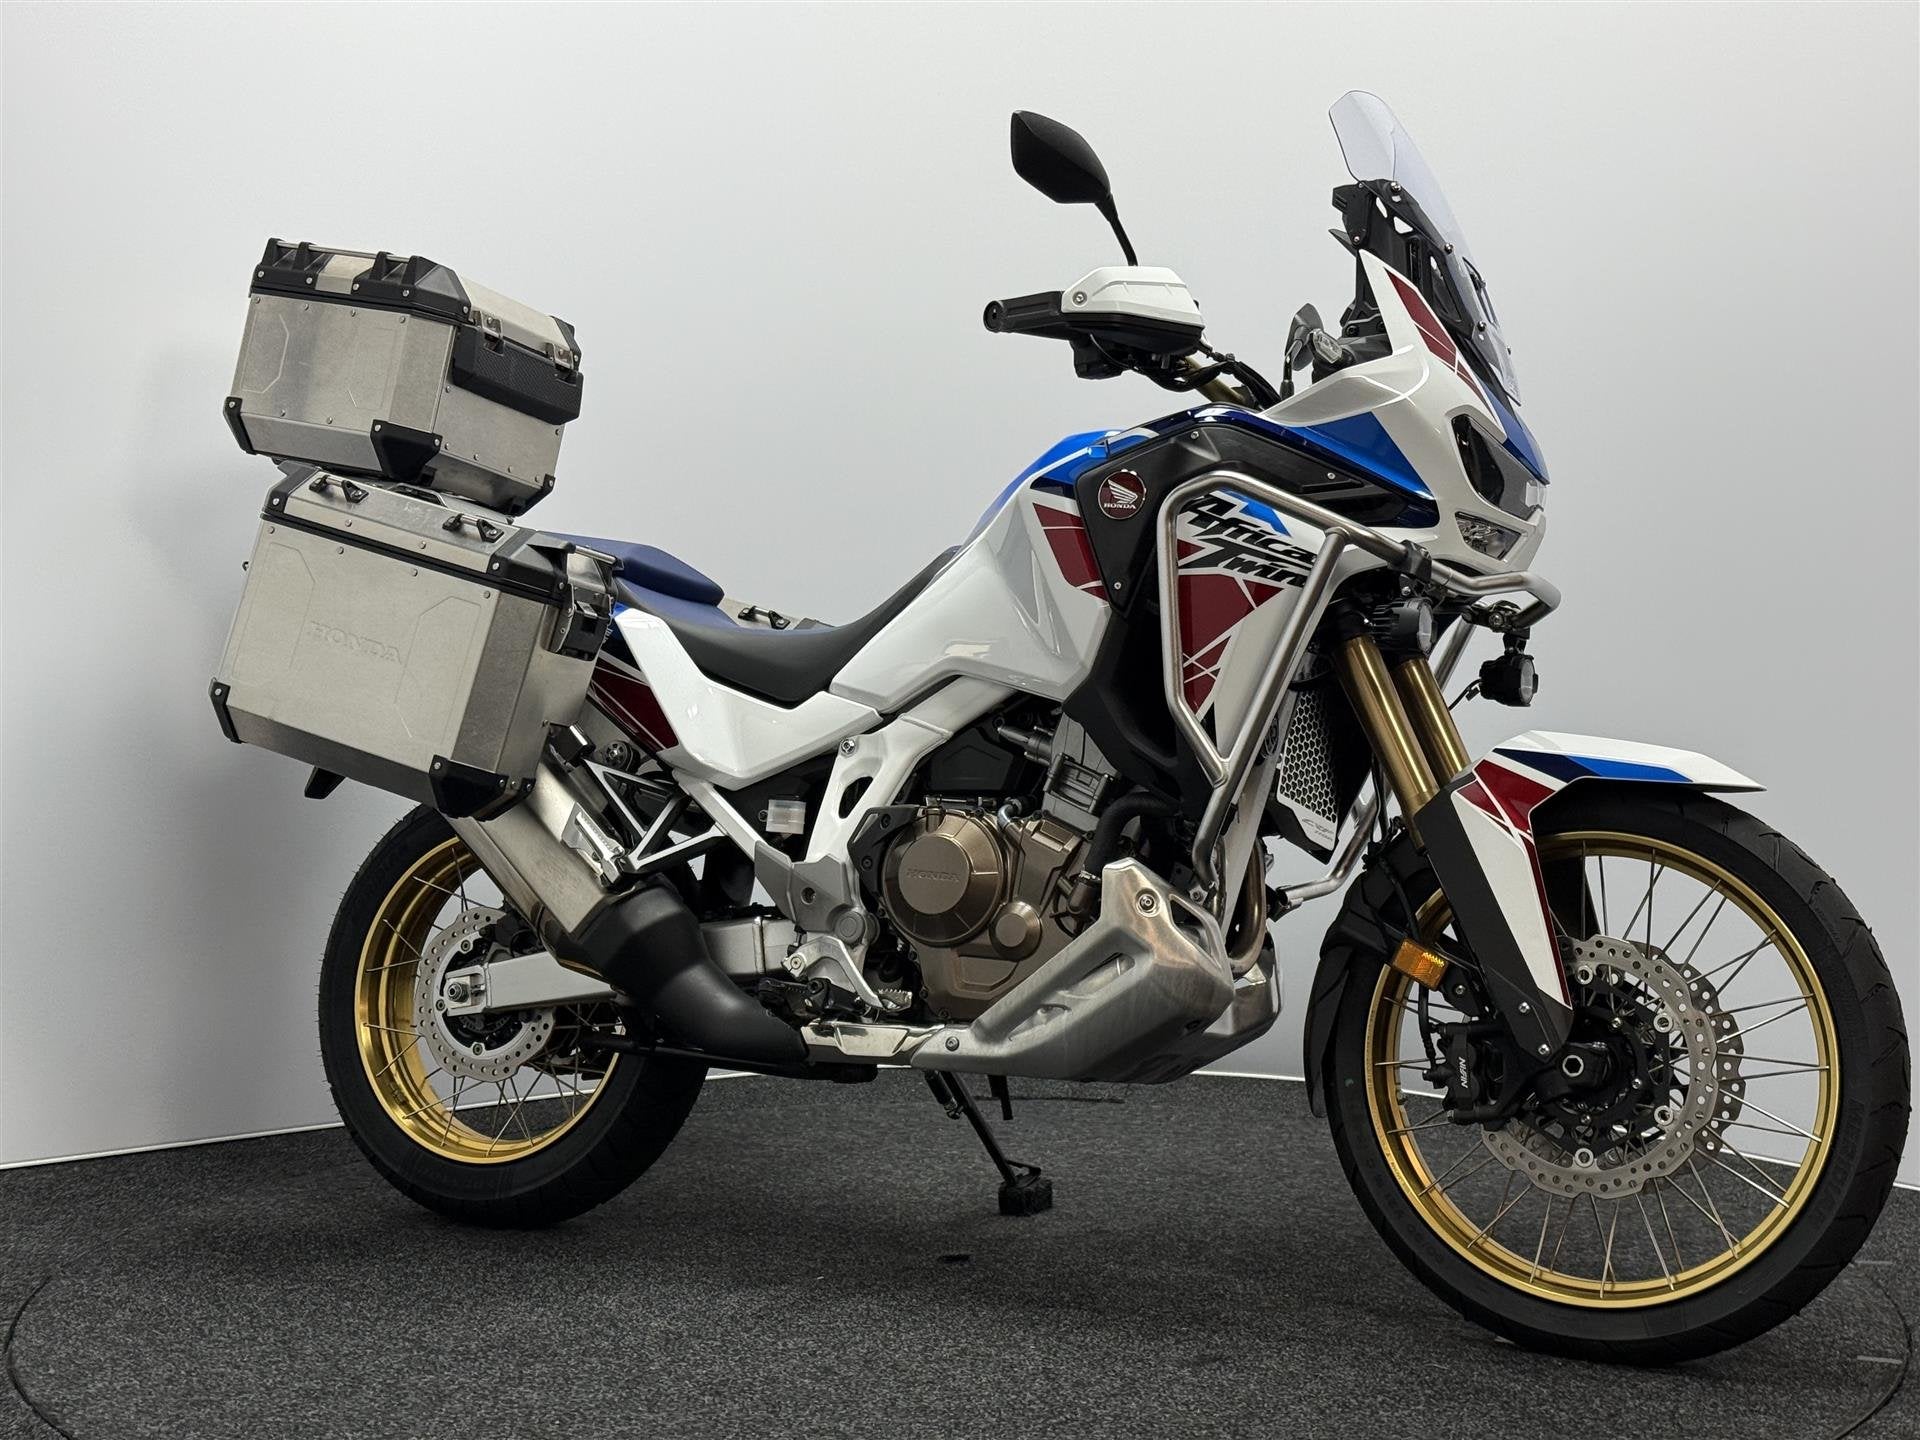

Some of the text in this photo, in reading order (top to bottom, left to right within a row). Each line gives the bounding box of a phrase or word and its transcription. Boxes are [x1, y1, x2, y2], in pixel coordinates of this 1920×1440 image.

[1178, 493, 1318, 565] Africa
[1178, 537, 1313, 588] Twin
[308, 620, 402, 665] HONDA
[905, 867, 961, 882] HONDA
